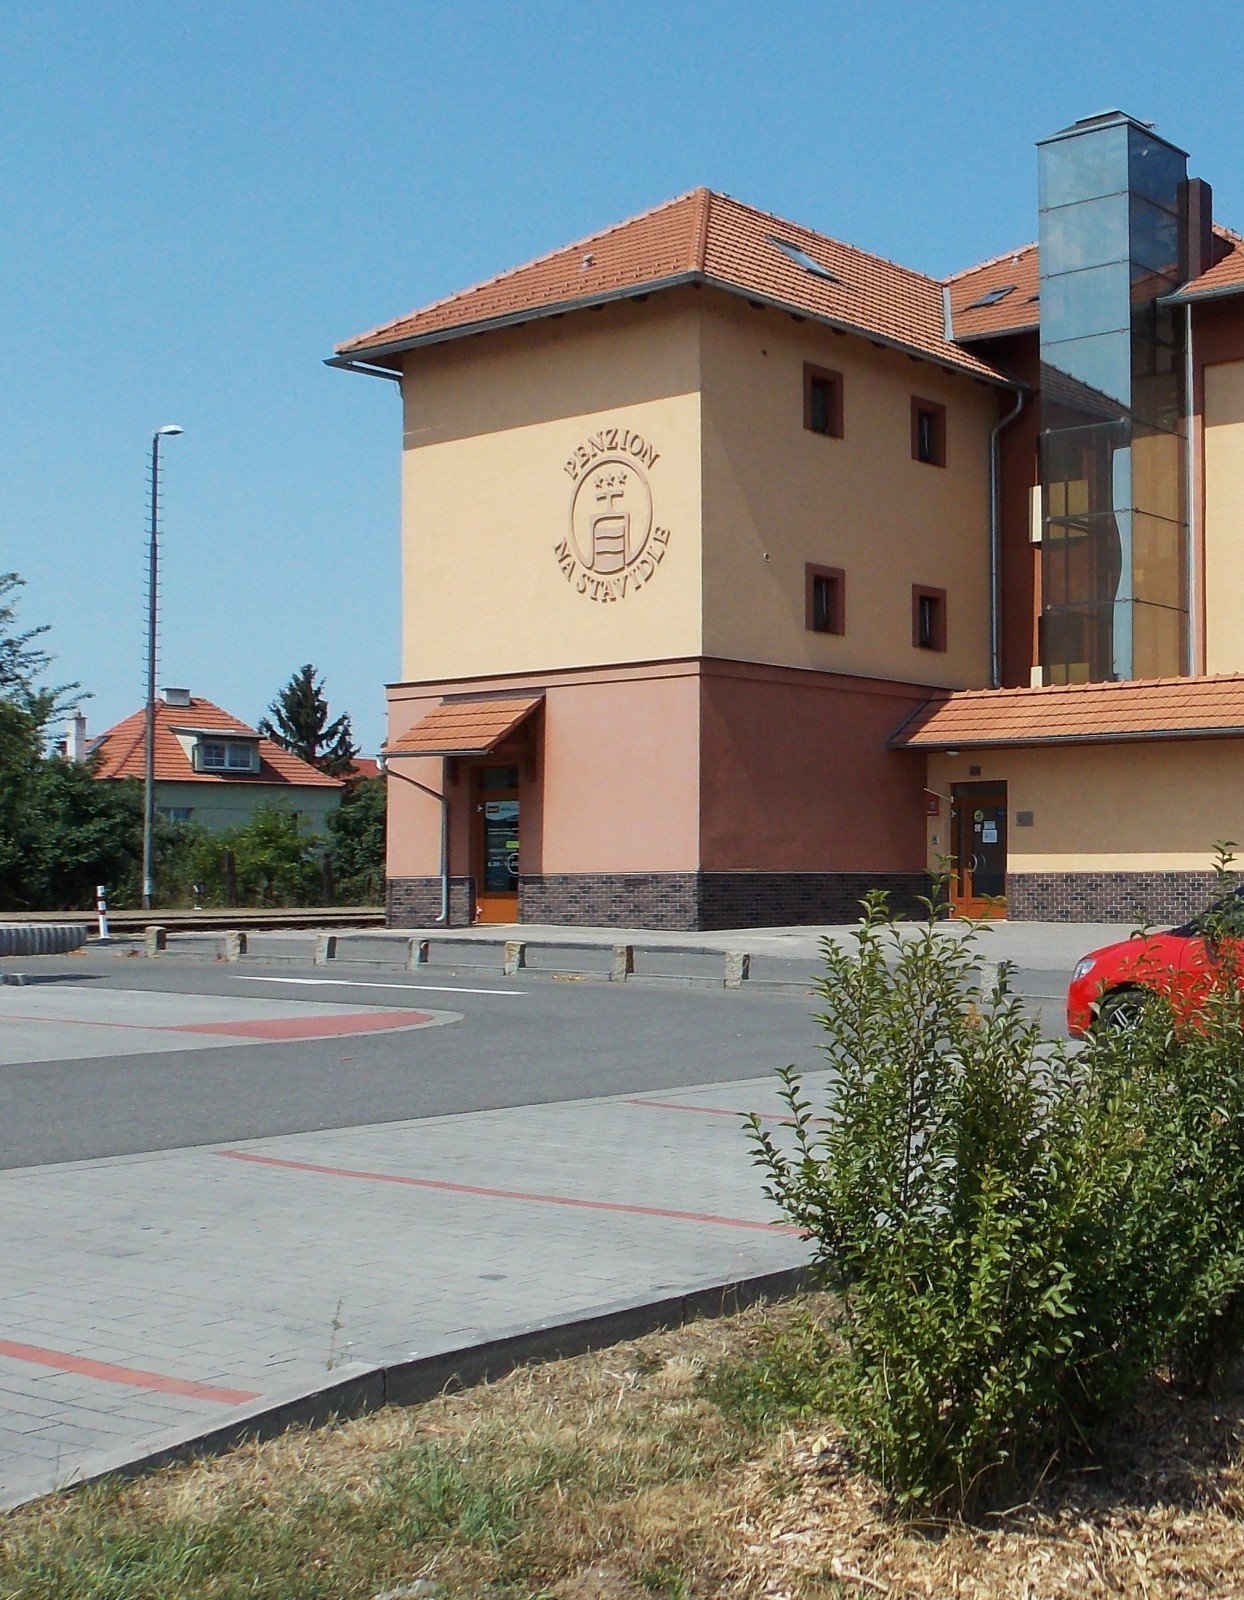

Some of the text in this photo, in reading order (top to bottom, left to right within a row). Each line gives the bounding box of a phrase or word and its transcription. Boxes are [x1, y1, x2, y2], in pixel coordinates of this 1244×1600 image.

[563, 428, 661, 480] PENZION
[553, 526, 671, 603] NA STAVIDLE
